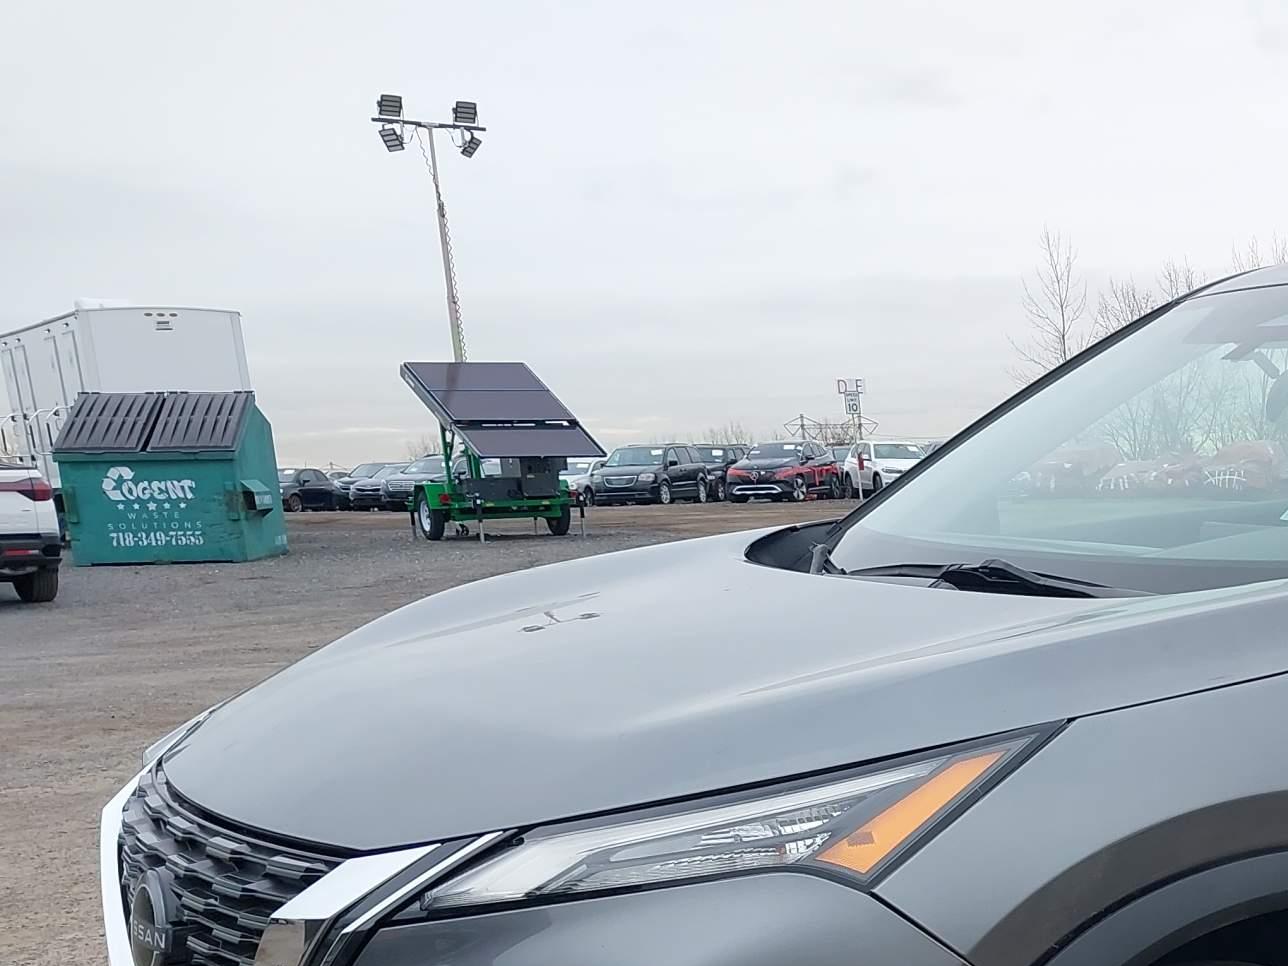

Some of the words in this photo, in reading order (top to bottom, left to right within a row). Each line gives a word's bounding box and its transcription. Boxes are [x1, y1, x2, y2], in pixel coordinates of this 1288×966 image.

[848, 403, 858, 412] 10
[128, 511, 180, 520] WASTE
[107, 520, 203, 530] SOLUTIONS
[109, 530, 205, 547] 718-349-7555
[133, 919, 166, 949] SSAN
